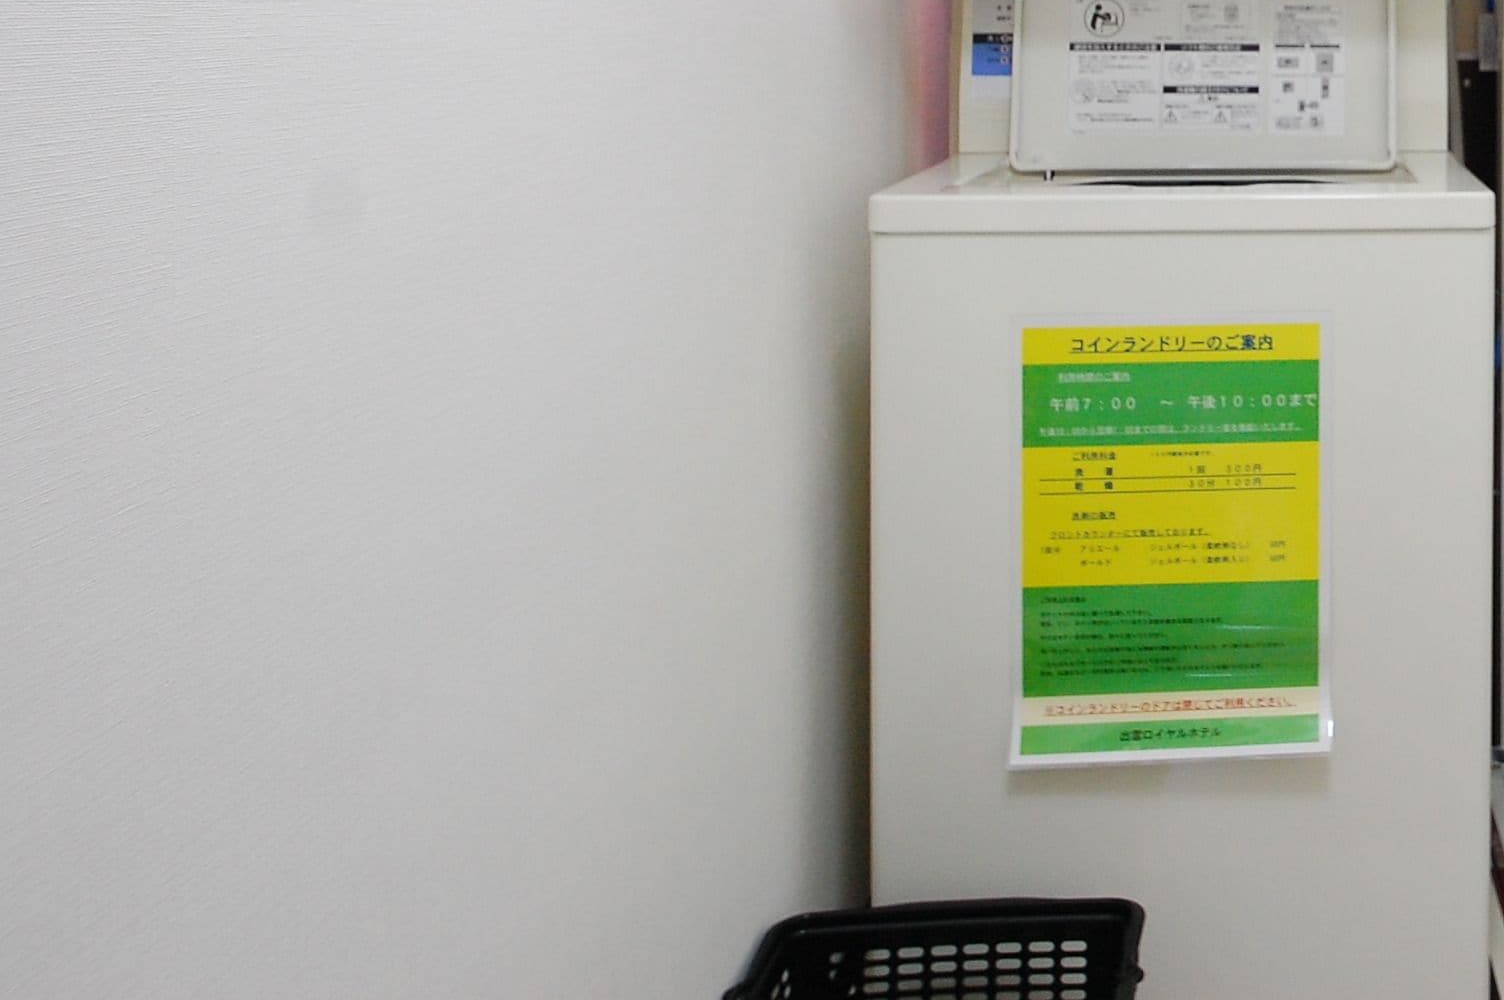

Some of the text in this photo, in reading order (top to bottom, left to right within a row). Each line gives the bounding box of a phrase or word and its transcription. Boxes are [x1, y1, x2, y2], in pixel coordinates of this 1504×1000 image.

[1072, 334, 1274, 352] コインランドリーのご案内
